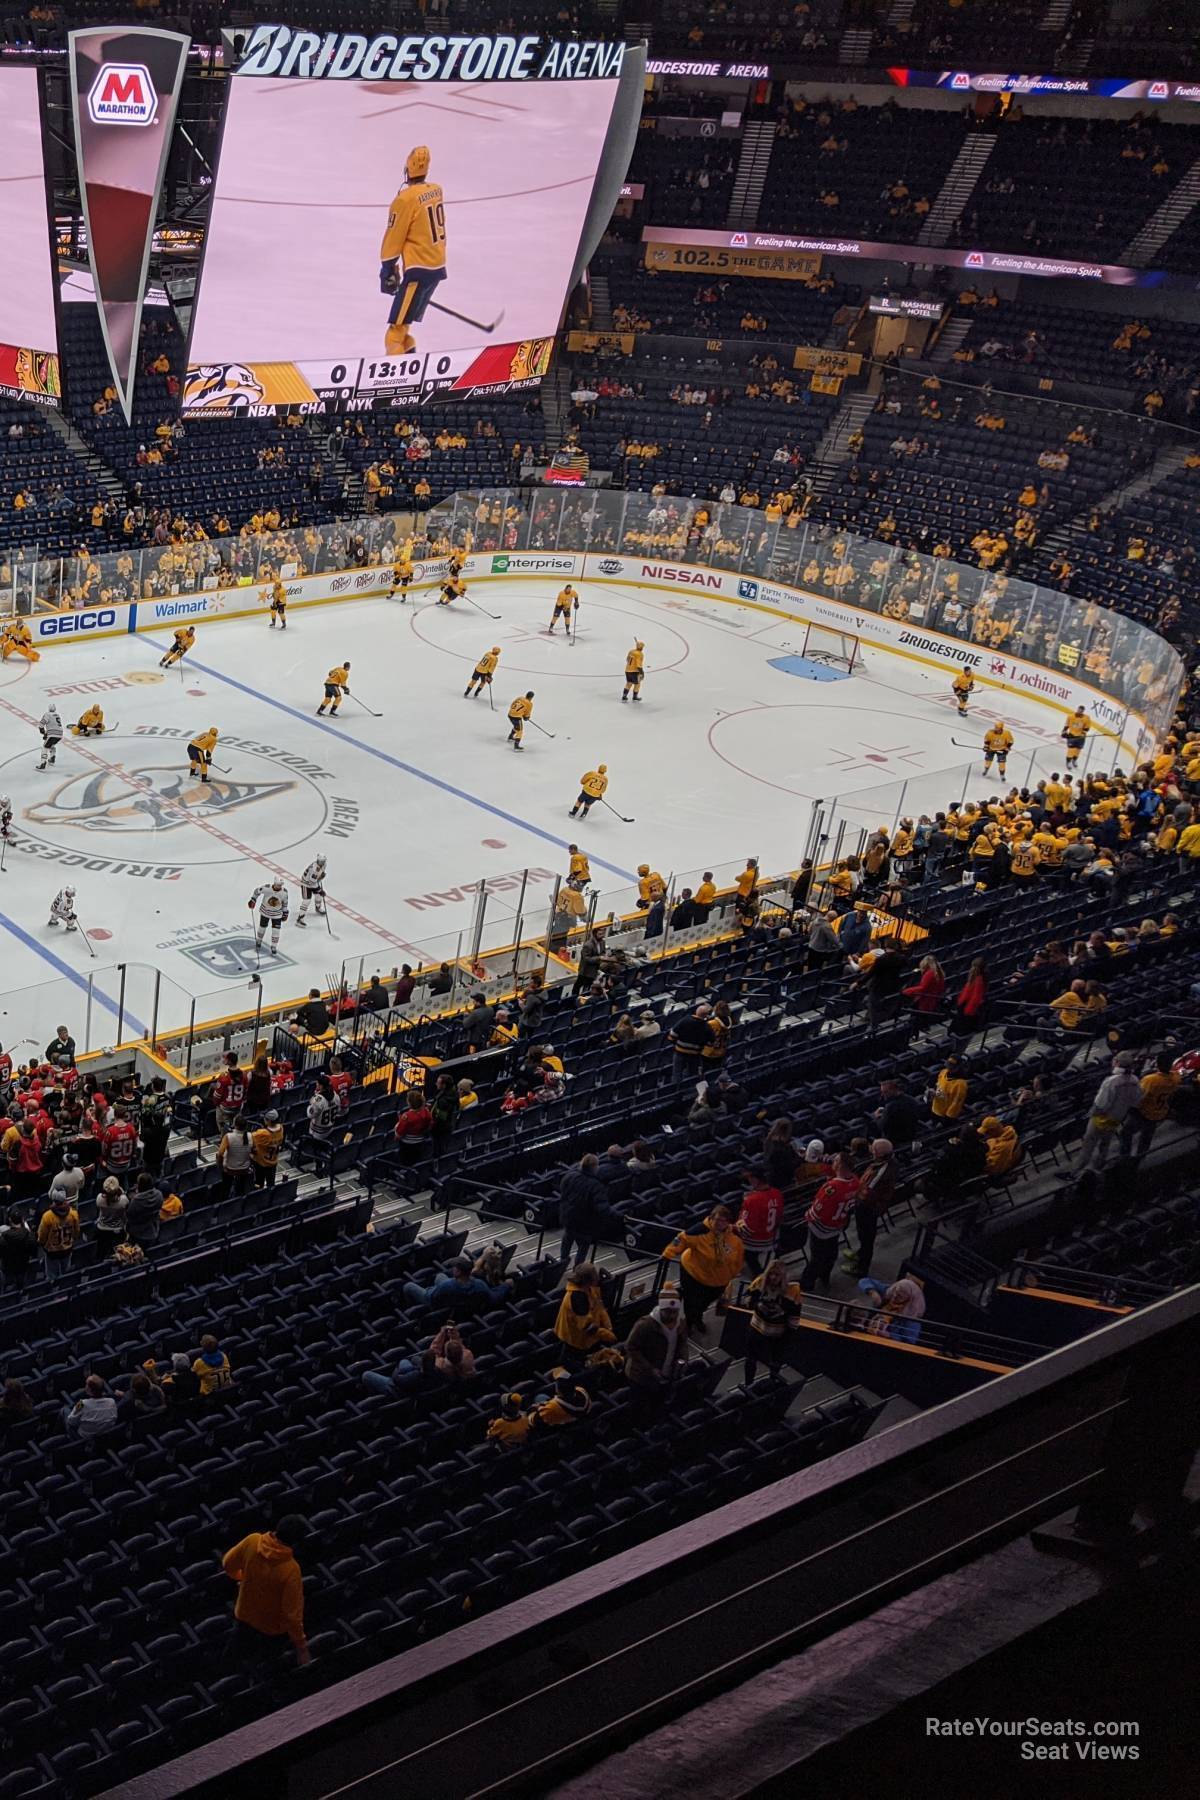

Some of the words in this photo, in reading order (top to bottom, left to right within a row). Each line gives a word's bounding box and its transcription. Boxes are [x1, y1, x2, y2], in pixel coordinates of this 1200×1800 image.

[238, 24, 539, 80] BRIDGESTONE
[542, 41, 626, 77] ARENA
[645, 62, 720, 76] RIDGESTONE
[727, 65, 768, 77] ARENA
[977, 78, 1007, 88] Fueling
[1008, 79, 1021, 87] the
[1022, 80, 1062, 90] American
[1063, 81, 1088, 92] Spirit.
[98, 103, 147, 115] MARATHON
[427, 203, 445, 243] 19
[755, 237, 783, 248] Fueling
[784, 240, 797, 248] the
[798, 240, 836, 251] American
[837, 243, 860, 253] Spirit.
[673, 250, 729, 267] 102.5
[757, 256, 817, 274] GAME
[991, 257, 1022, 269] Fueling
[1023, 259, 1036, 269] the
[1037, 261, 1076, 273] American
[1077, 265, 1102, 278] Spirit.
[901, 300, 941, 311] NASHVILLE
[907, 308, 931, 316] HOTEL
[330, 364, 347, 384] 0
[368, 359, 421, 379] 13:10
[436, 356, 451, 374] 0
[319, 391, 335, 399] SOG
[391, 397, 407, 406] 6:30
[408, 396, 419, 404] PM
[248, 405, 277, 417] NBA
[300, 403, 326, 415] CHA
[346, 398, 374, 412] NYK
[497, 558, 572, 570] enterprise
[641, 565, 722, 589] NISSAN
[155, 599, 206, 617] Walmart
[760, 594, 780, 605] BANK
[40, 610, 116, 635] GEICO
[815, 606, 854, 623] VANDERBILT
[898, 630, 983, 667] BRIDGESTONE
[1010, 666, 1072, 701] Lochinvar
[1091, 699, 1124, 734] xfinity
[134, 724, 335, 781] BRIGESTONE
[322, 795, 360, 839] ARENA
[404, 866, 557, 911] NISSAN
